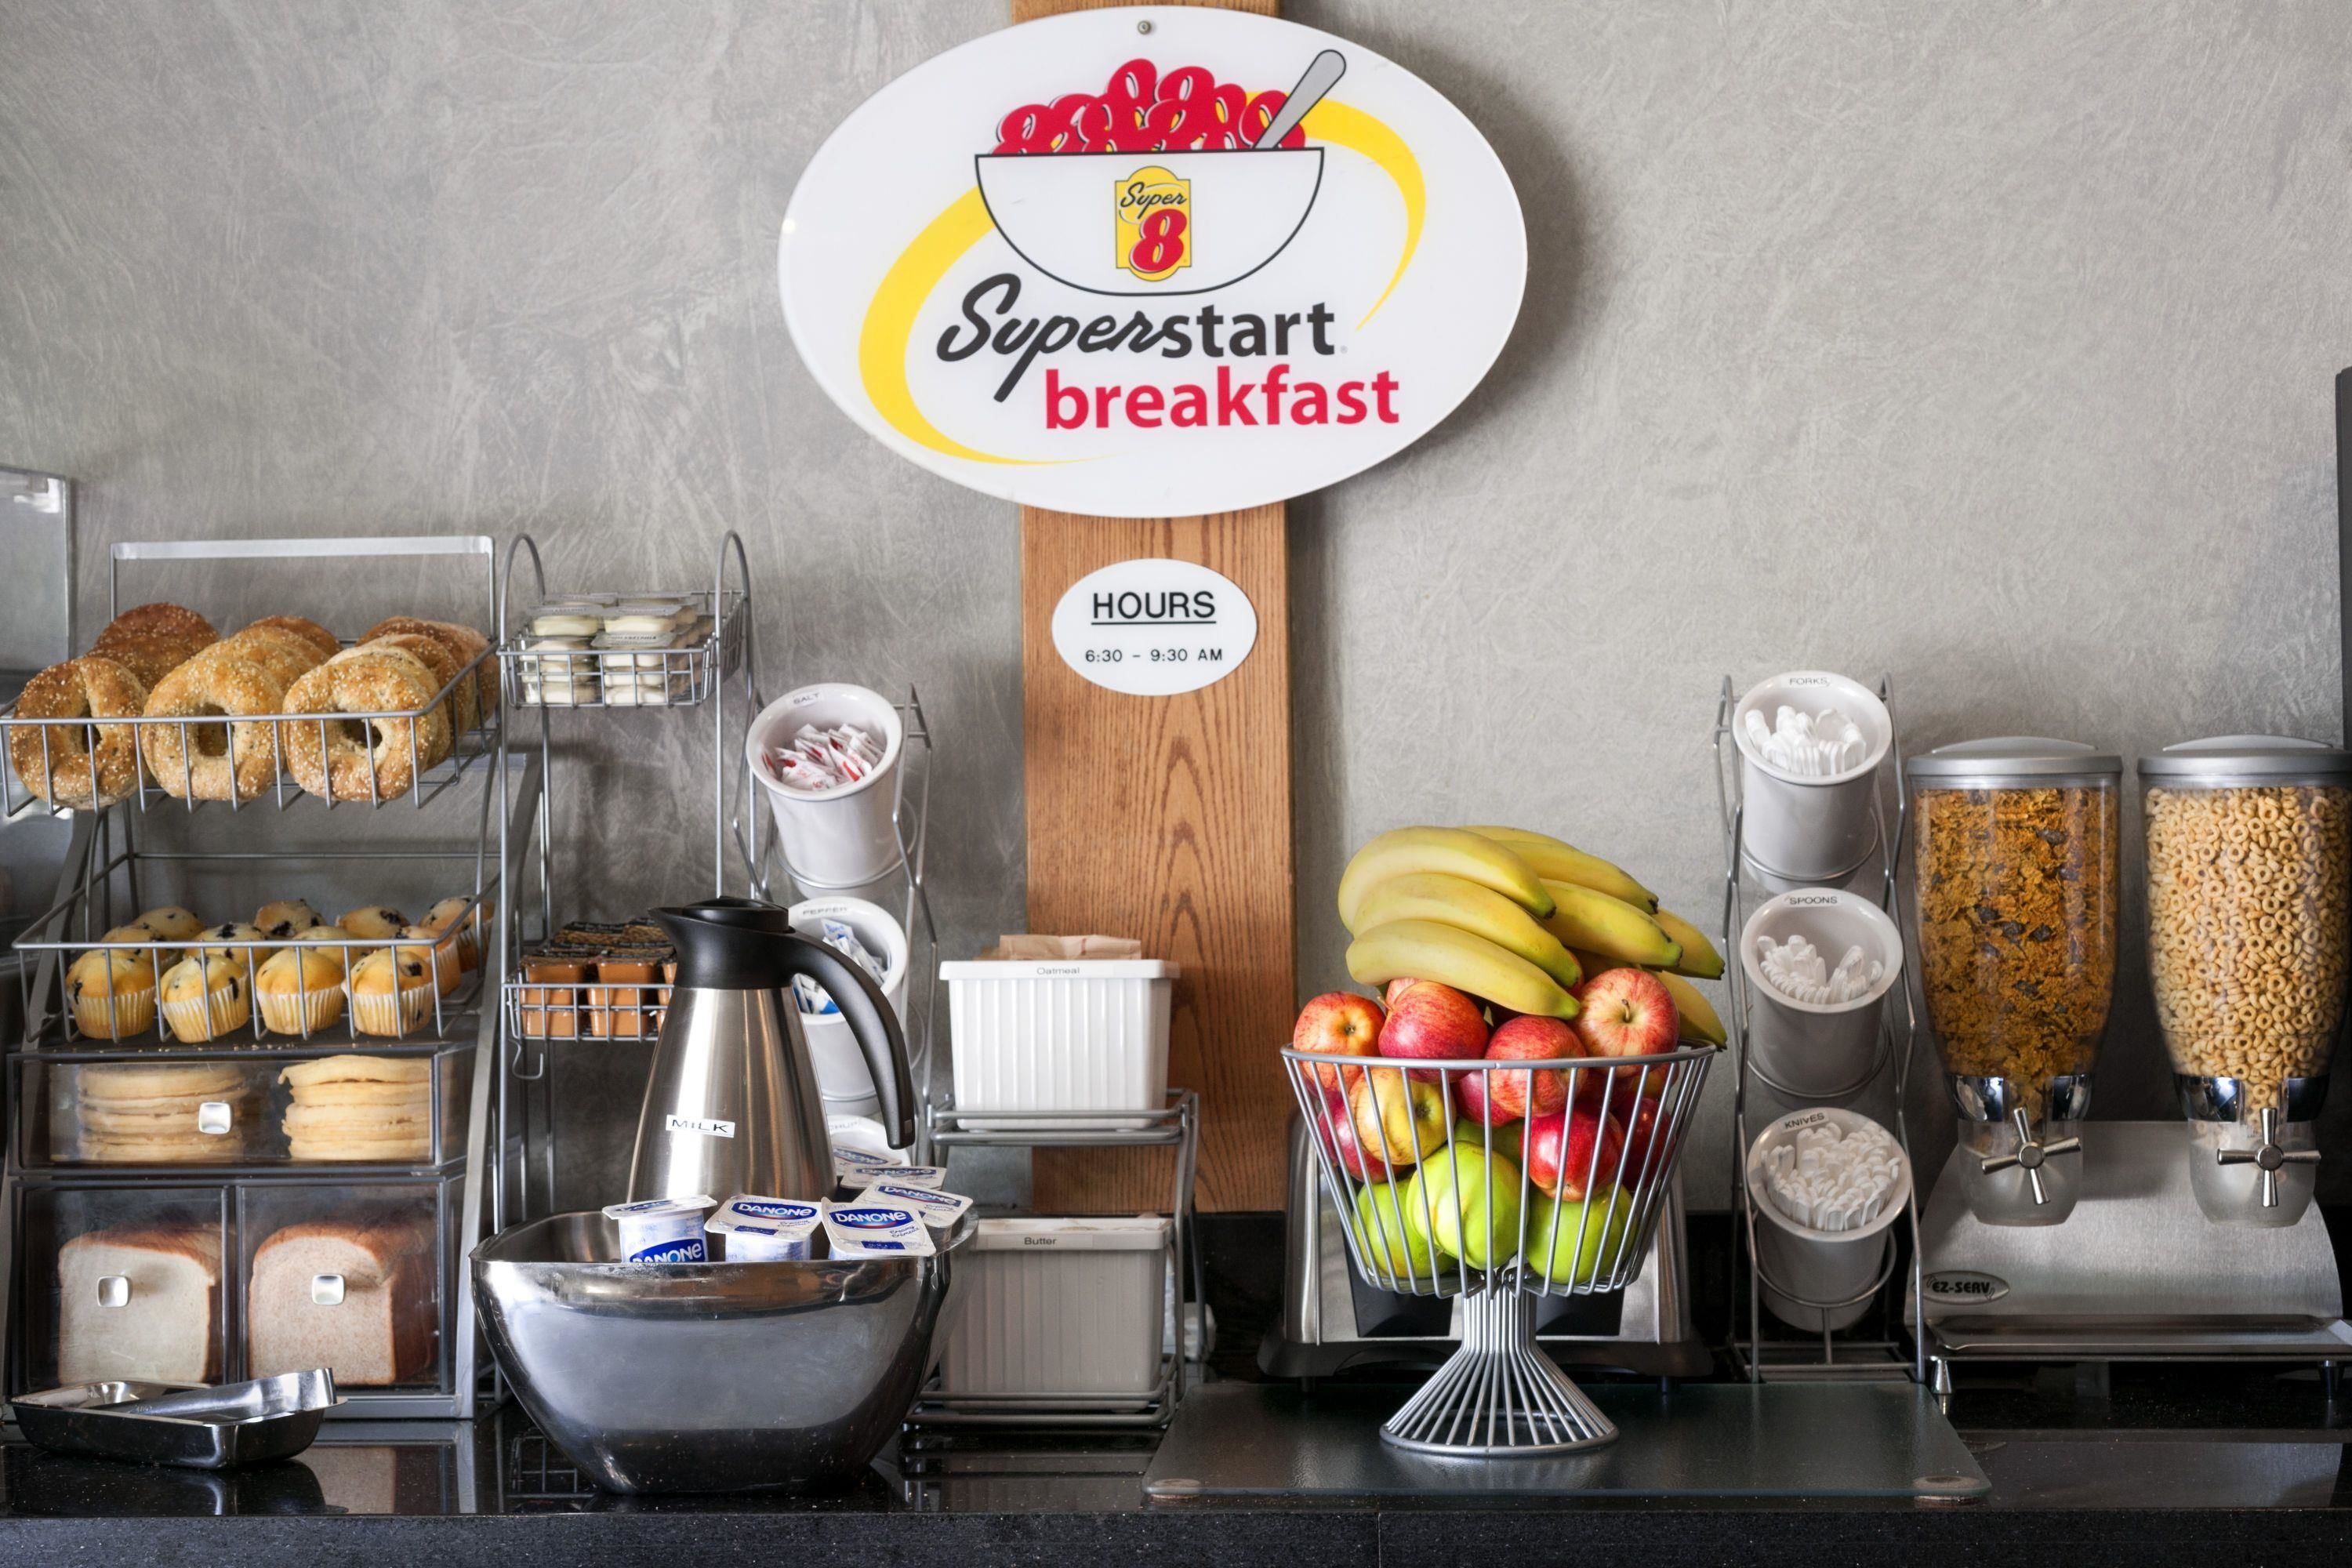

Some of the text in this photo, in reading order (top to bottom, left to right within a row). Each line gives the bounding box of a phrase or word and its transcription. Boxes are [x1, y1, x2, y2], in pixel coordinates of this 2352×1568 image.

[1120, 182, 1187, 220] Super
[1129, 209, 1187, 274] 8
[936, 274, 1334, 402] Superstart
[1046, 364, 1399, 430] breakfast
[1093, 591, 1215, 619] HOURS
[1085, 649, 1123, 662] 6:30
[1151, 648, 1187, 662] 9:30
[1198, 648, 1222, 662] AM
[793, 691, 820, 704] SALT
[1790, 896, 1838, 906] SPOONS
[1036, 967, 1080, 975] Oatmeal
[672, 1119, 728, 1133] MILK
[1784, 1112, 1825, 1129] KNIVES
[1024, 1236, 1056, 1246] Butter
[1932, 1281, 1990, 1294] EZ-SERV
